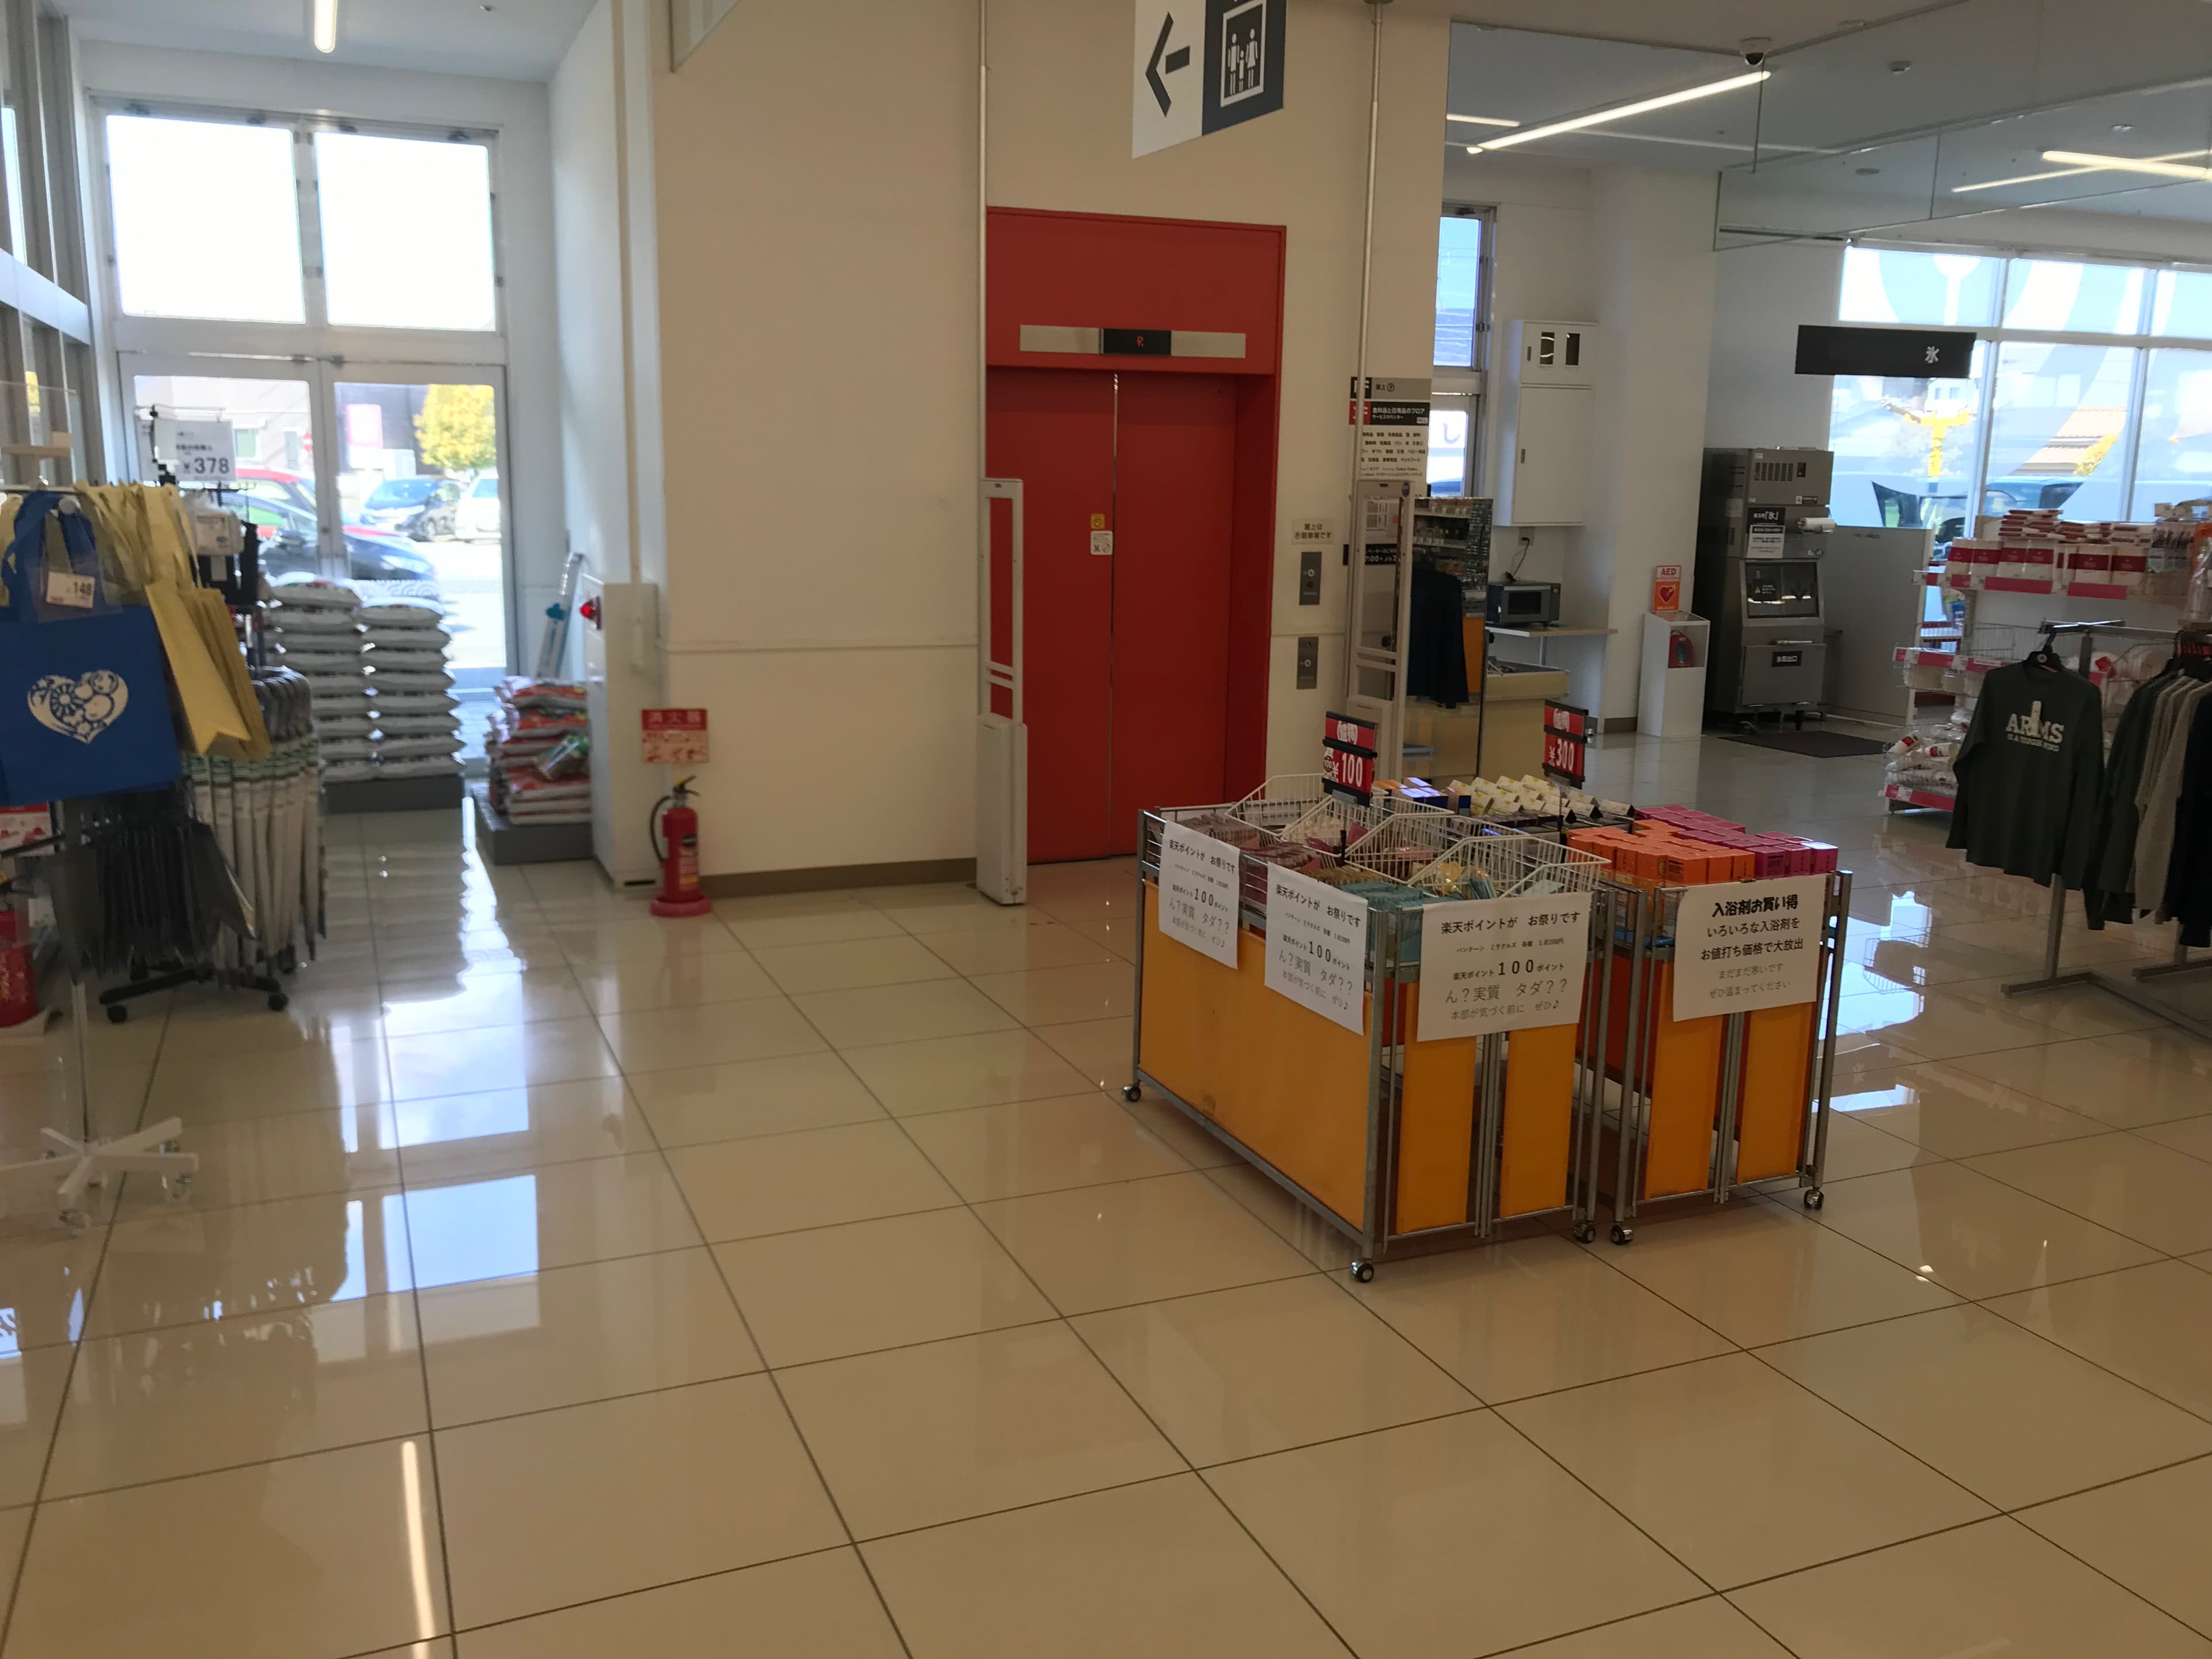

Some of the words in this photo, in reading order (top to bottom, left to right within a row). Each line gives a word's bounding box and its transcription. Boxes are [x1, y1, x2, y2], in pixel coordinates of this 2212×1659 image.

[1925, 346, 1940, 363] 氷
[1169, 839, 1206, 861] 楽天ポイントが
[1210, 855, 1236, 874] お祭りです
[1275, 884, 1320, 910] 楽天ポイントが
[1327, 905, 1361, 927] お祭りです
[1712, 894, 1798, 918] 入浴剤お買い得
[1441, 916, 1518, 934] 楽天ポイントが
[1528, 911, 1580, 926] お祭りです
[1707, 917, 1800, 937] いろいろな入浴剤を
[1700, 938, 1803, 961] お値打ち価格で大放出
[1719, 963, 1784, 979] まだまだ寒いです
[1709, 980, 1791, 998] ぜひ温まってください
